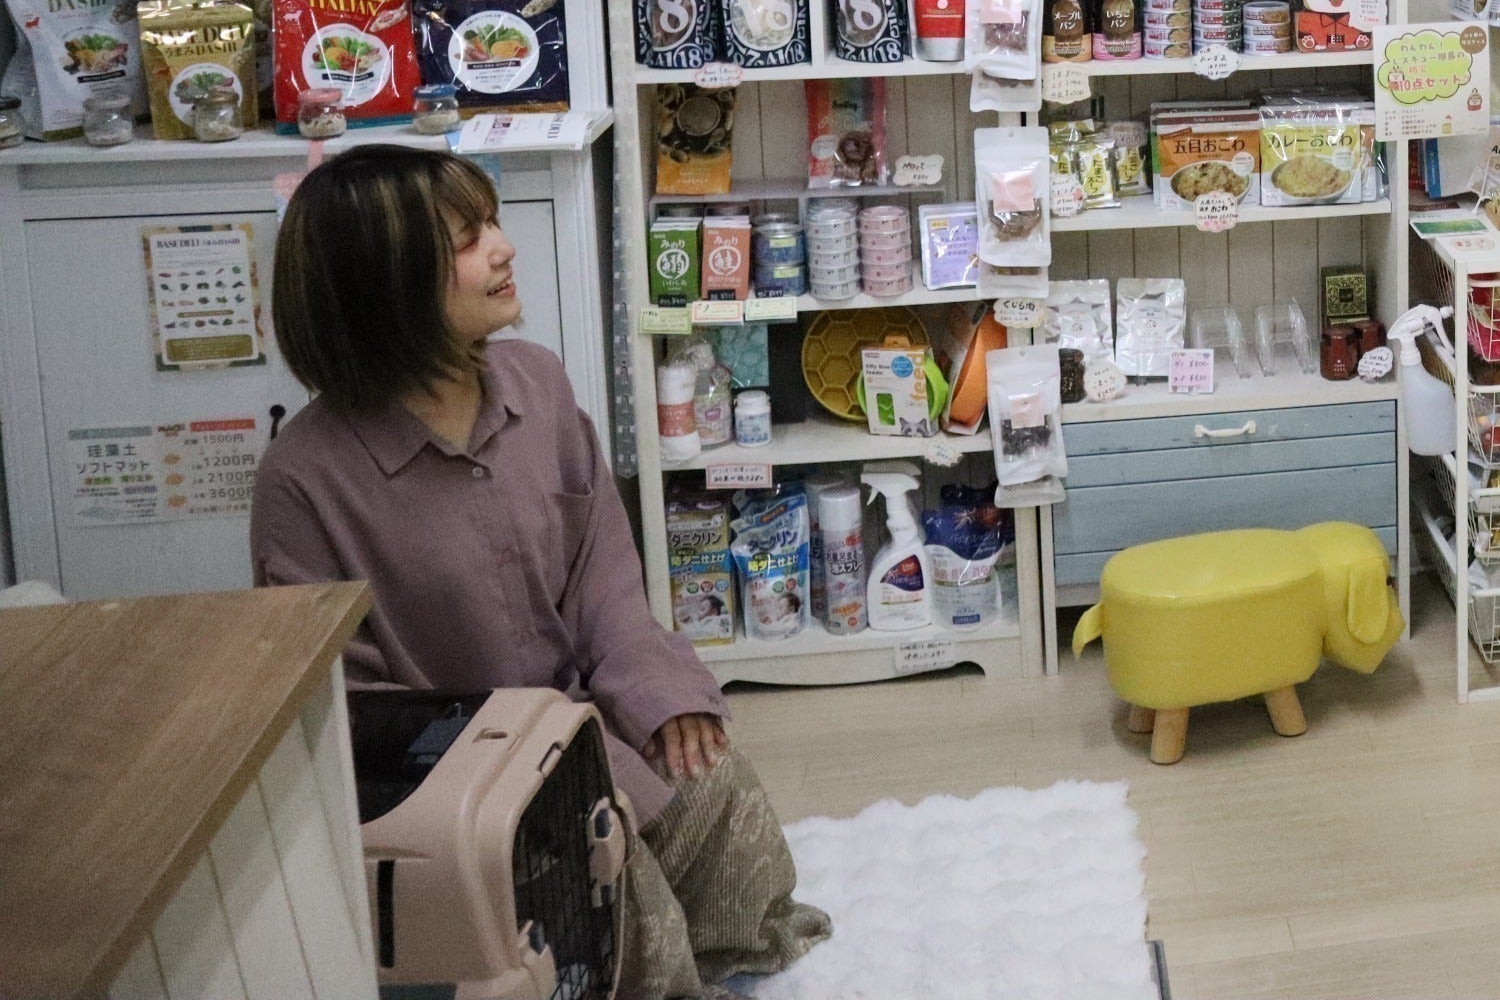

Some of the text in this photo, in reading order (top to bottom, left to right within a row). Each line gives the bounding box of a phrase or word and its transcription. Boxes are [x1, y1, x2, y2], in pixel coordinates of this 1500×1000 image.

[1174, 137, 1246, 155] 五目おこわ
